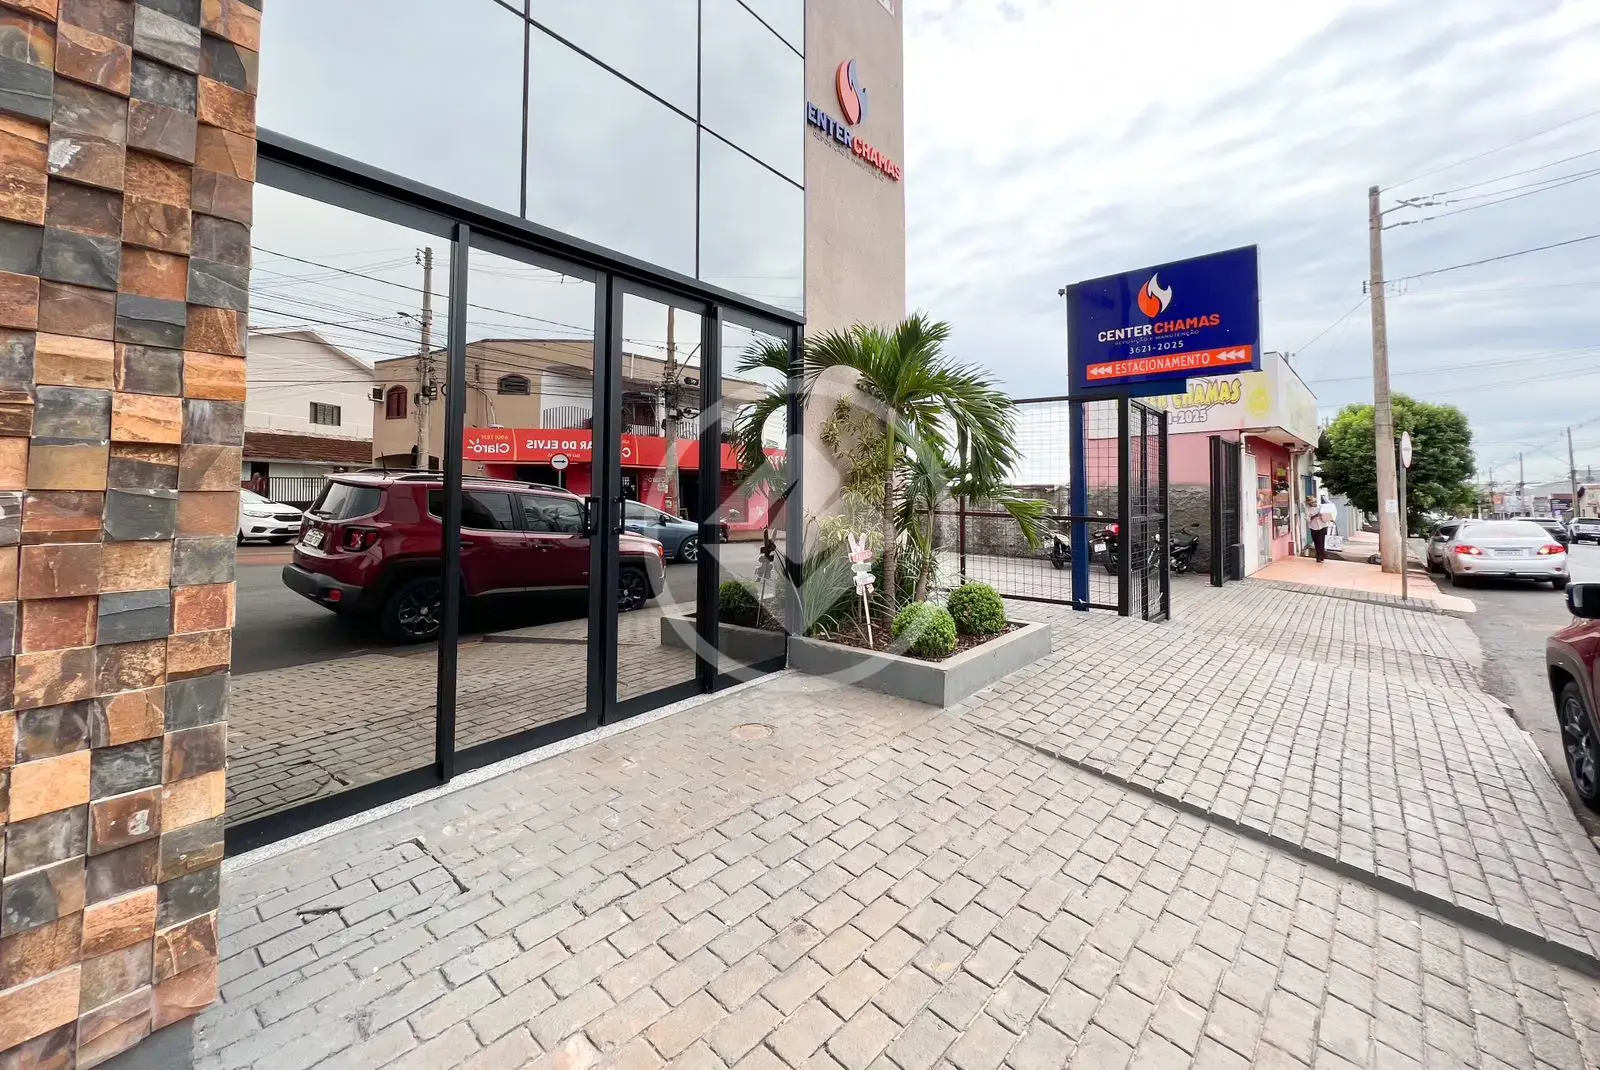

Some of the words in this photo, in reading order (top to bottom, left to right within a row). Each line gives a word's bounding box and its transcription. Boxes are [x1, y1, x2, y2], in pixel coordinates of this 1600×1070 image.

[807, 101, 853, 148] ENTER
[851, 136, 901, 182] CHAMAS
[1098, 324, 1152, 342] CENTER
[1153, 313, 1221, 334] CHAMAS
[1129, 340, 1184, 355] 3621-2025
[1115, 352, 1210, 375] ESTACIONAMENTO
